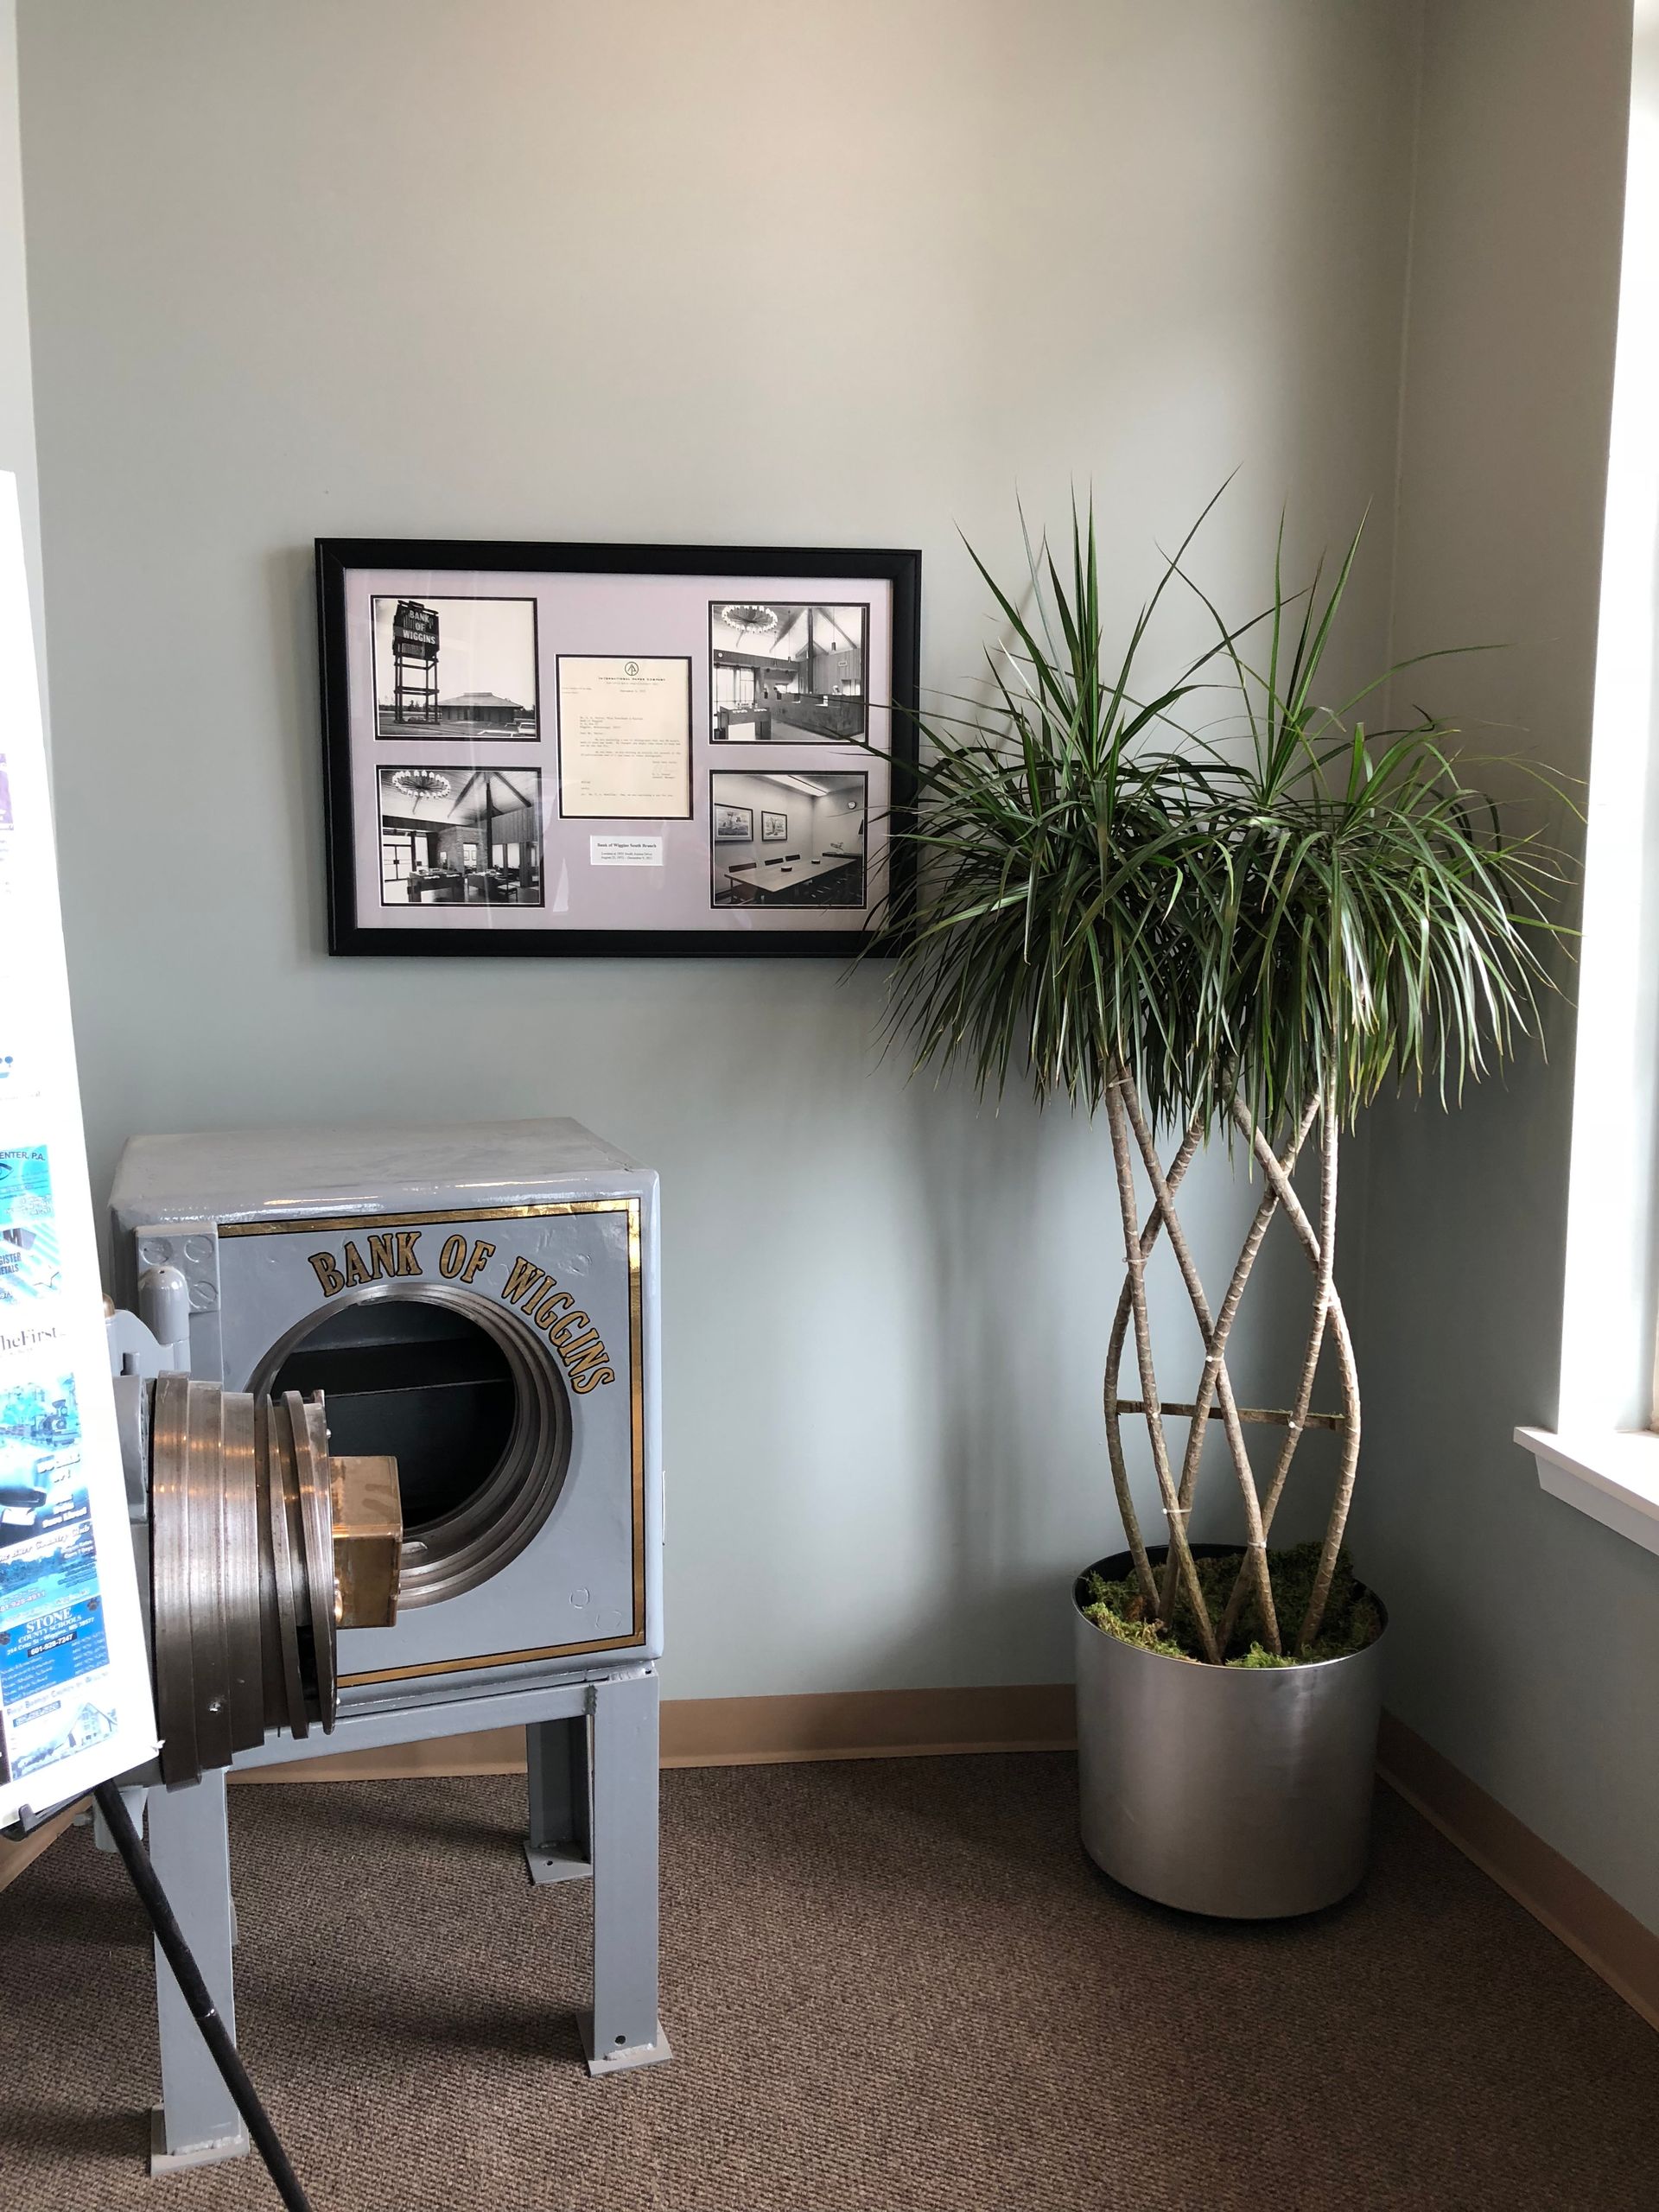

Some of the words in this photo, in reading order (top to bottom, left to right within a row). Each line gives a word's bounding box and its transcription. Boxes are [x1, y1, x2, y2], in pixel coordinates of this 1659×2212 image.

[410, 610, 429, 622] BANK
[403, 629, 435, 645] WIGGINS
[415, 622, 426, 632] OF
[0, 1151, 29, 1160] ENTER,
[0, 1252, 22, 1266] GISTER
[308, 1231, 422, 1297] BANK
[439, 1234, 496, 1284] OF
[501, 1255, 615, 1395] WIGGINS
[0, 1327, 57, 1351] heFirst
[0, 1591, 46, 1611] 01-928-4911
[18, 1628, 48, 1643] COUNTY
[49, 1615, 82, 1631] SCHOOLS
[26, 1607, 73, 1634] STONE
[30, 1633, 73, 1656] 601-928-7247
